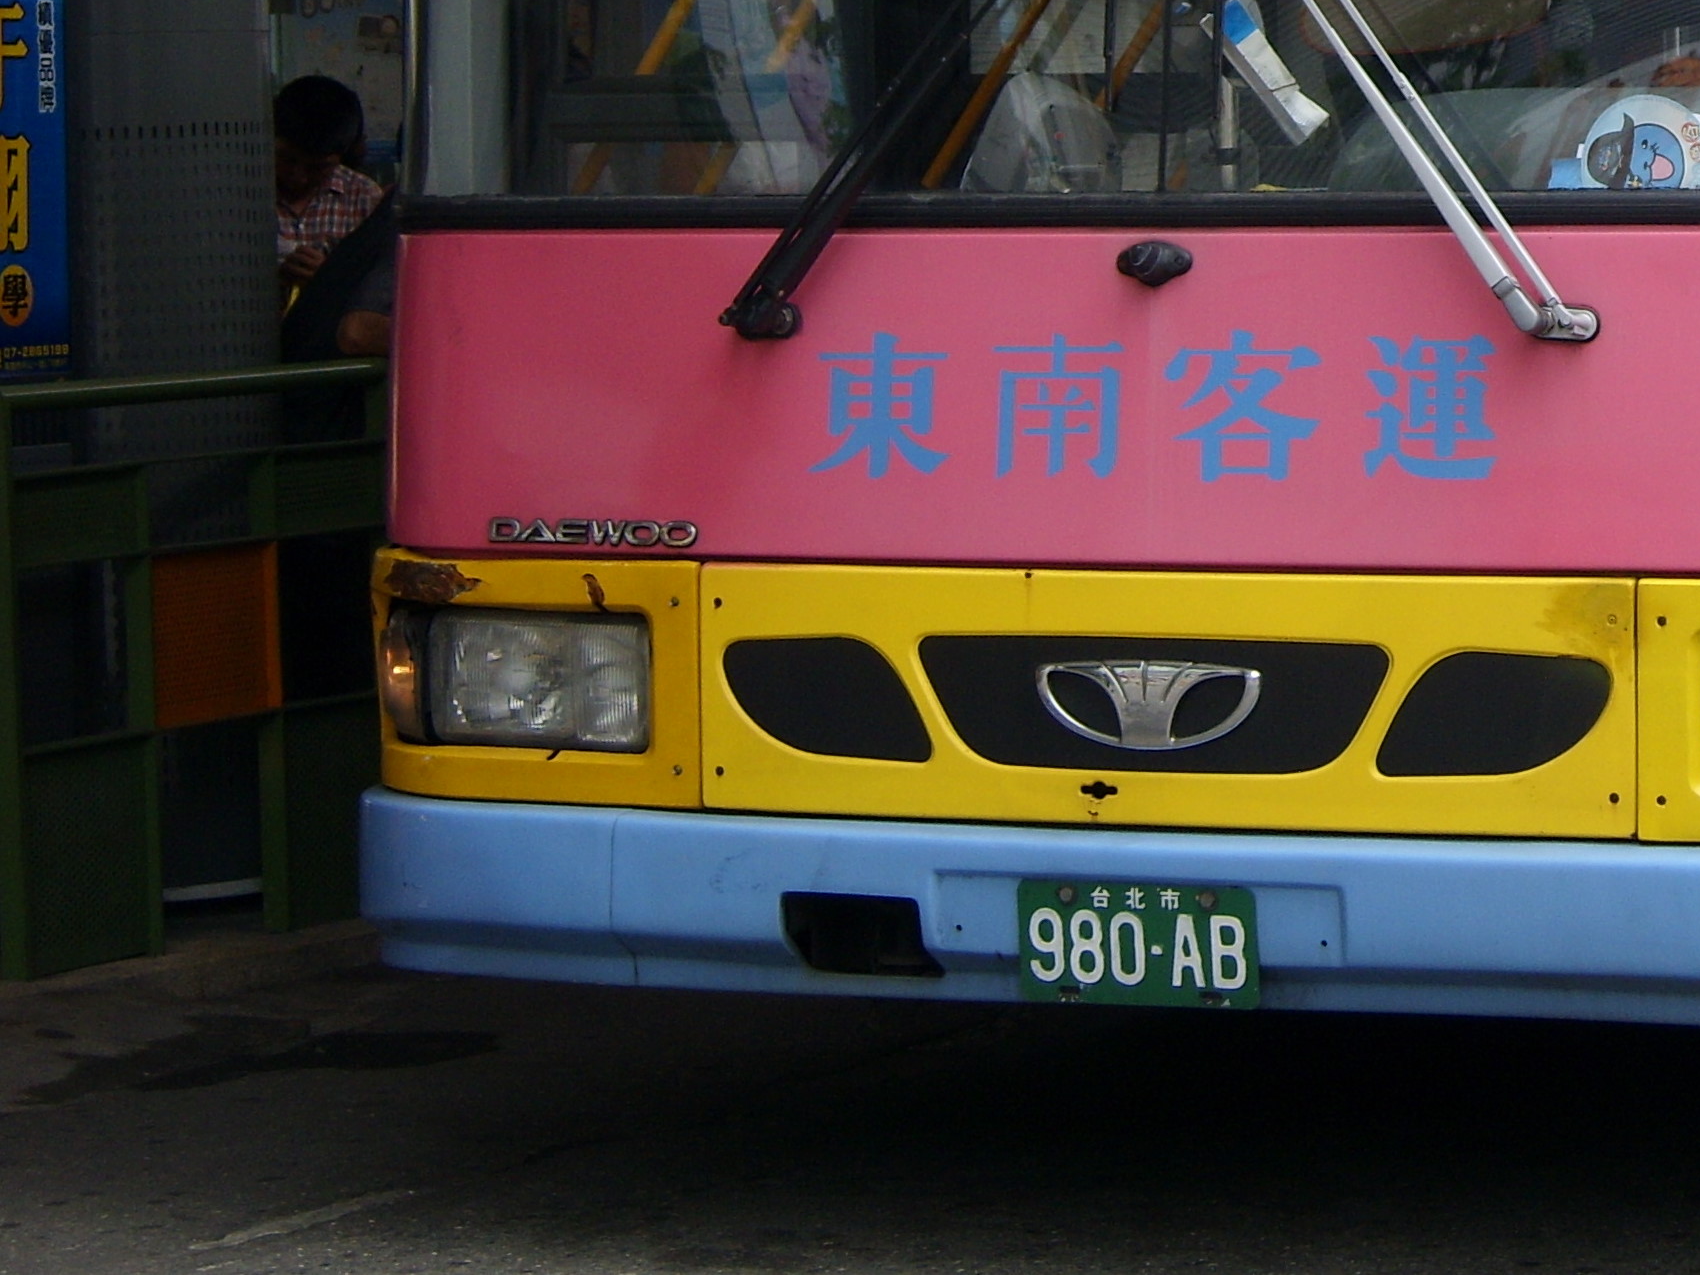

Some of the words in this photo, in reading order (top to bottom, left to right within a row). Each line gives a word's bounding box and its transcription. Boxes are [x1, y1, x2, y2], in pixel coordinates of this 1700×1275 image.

[806, 328, 1501, 483] 東南客運
[490, 516, 697, 549] DAEWOO
[1090, 885, 1182, 911] 台北市
[1028, 906, 1248, 991] 980-AB
